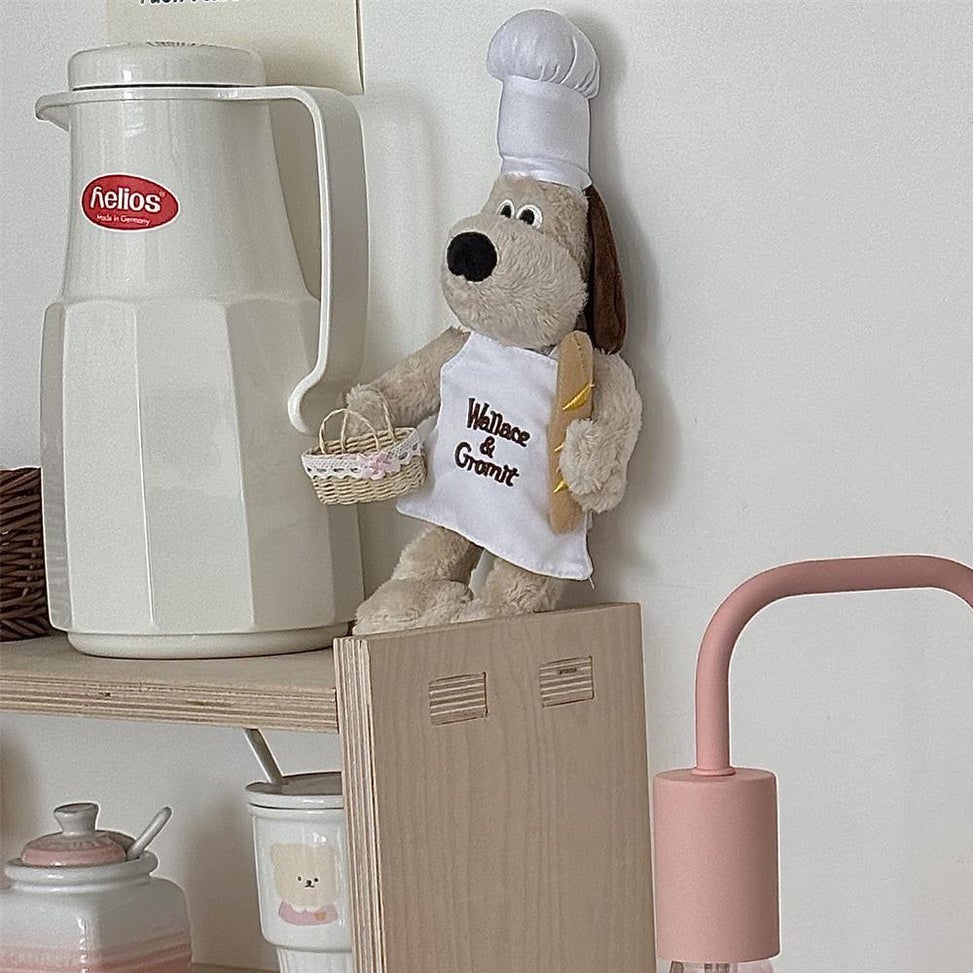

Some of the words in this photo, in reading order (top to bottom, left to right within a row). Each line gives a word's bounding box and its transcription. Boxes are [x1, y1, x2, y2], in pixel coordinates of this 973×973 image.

[120, 214, 151, 227] Germany
[466, 397, 531, 448] Wallace
[454, 441, 520, 487] Gromit
[479, 435, 496, 459] &
